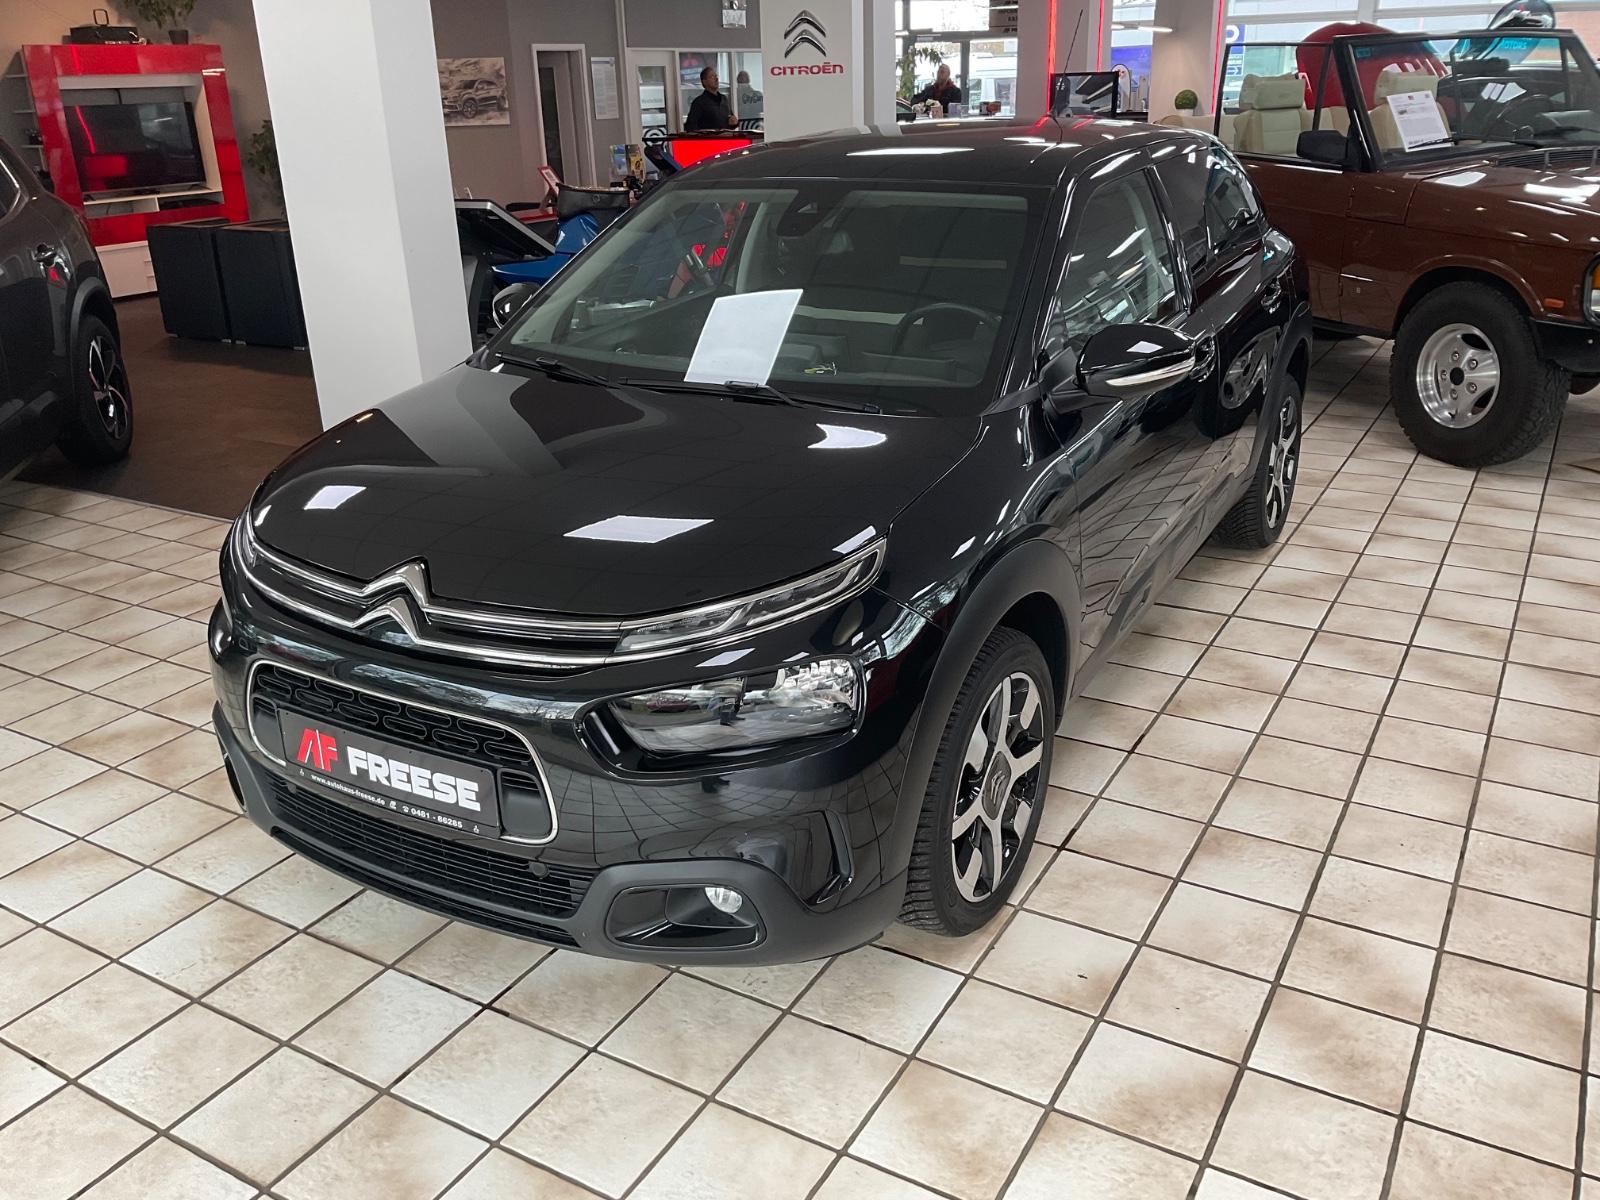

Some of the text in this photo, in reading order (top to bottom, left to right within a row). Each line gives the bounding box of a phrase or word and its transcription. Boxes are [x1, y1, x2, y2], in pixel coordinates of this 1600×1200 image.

[310, 774, 386, 806] www.autohaus-freese.de
[410, 807, 431, 820] 0481
[346, 745, 481, 812] FREESE
